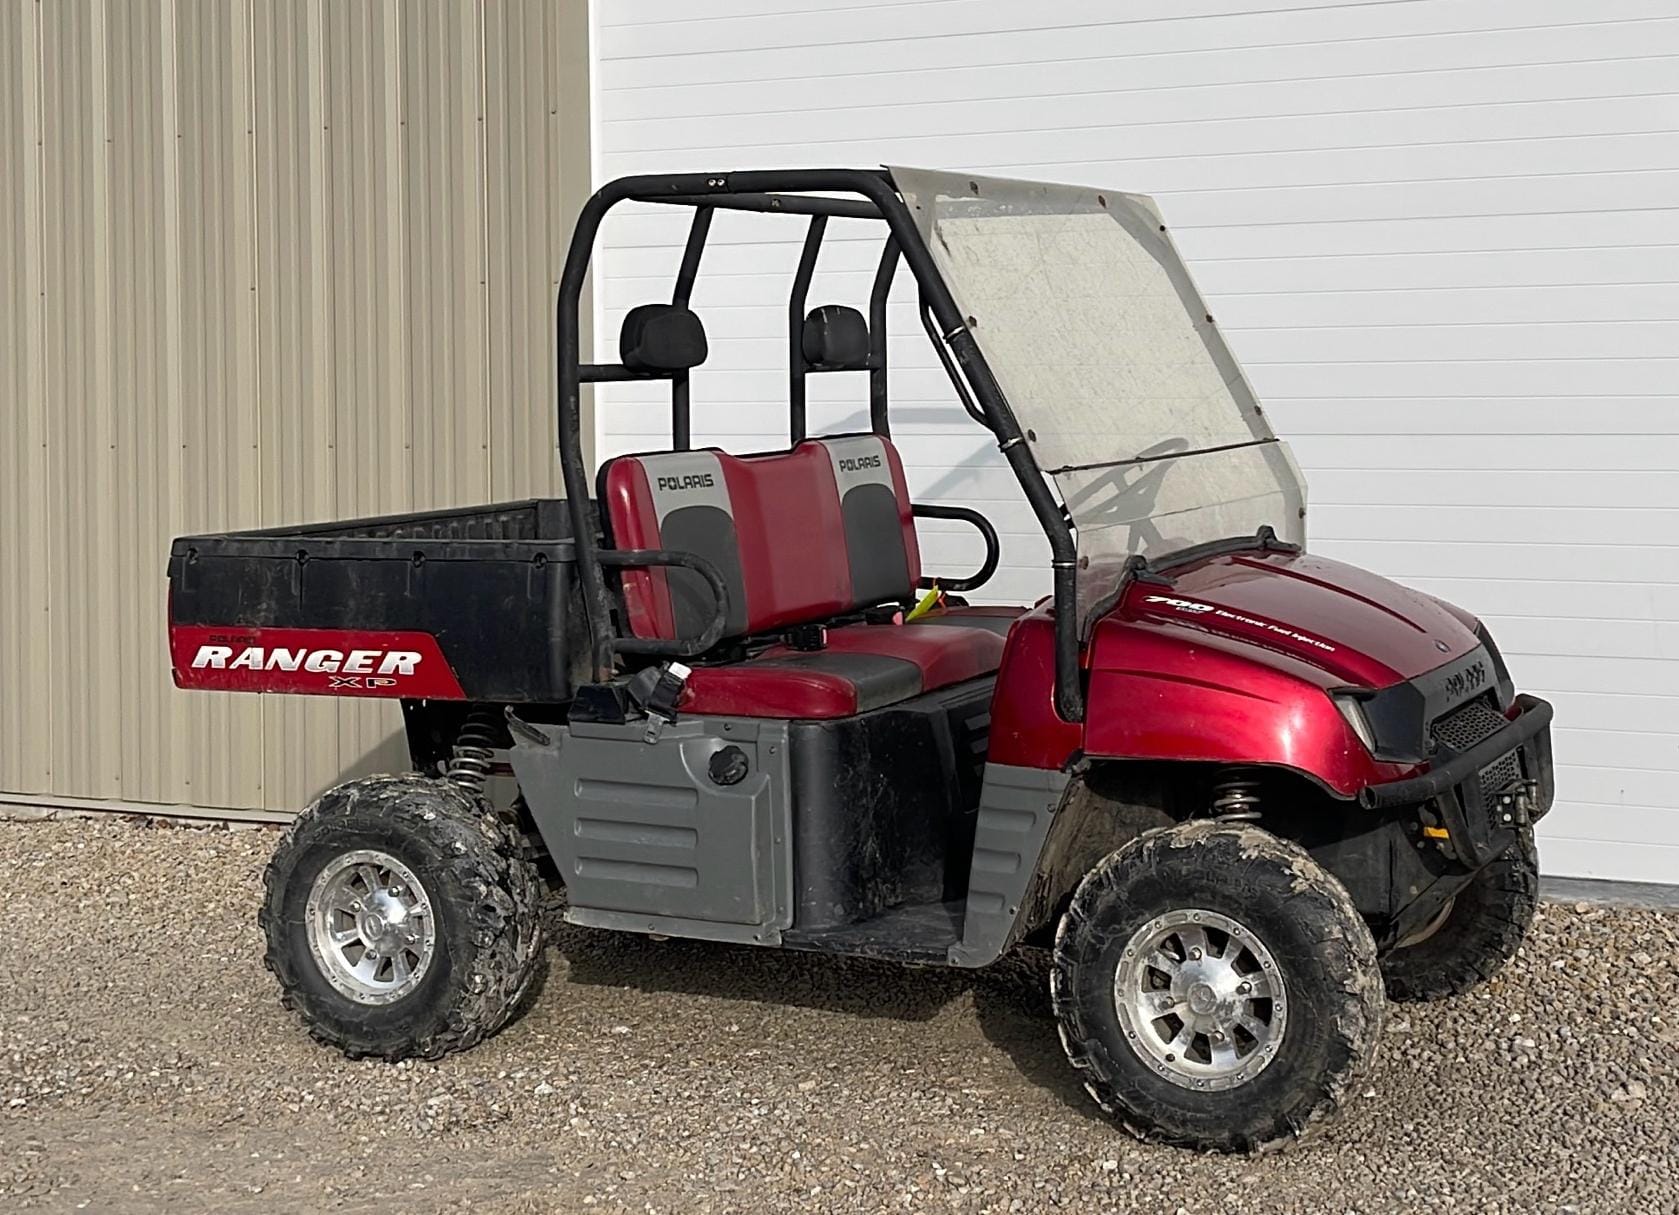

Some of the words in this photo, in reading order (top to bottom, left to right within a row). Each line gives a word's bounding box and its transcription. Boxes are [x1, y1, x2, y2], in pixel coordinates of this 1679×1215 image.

[839, 455, 881, 472] POLARIS
[658, 473, 714, 491] POLARIS
[1144, 595, 1215, 612] 700
[191, 645, 422, 675] RANGER
[328, 676, 397, 688] XP
